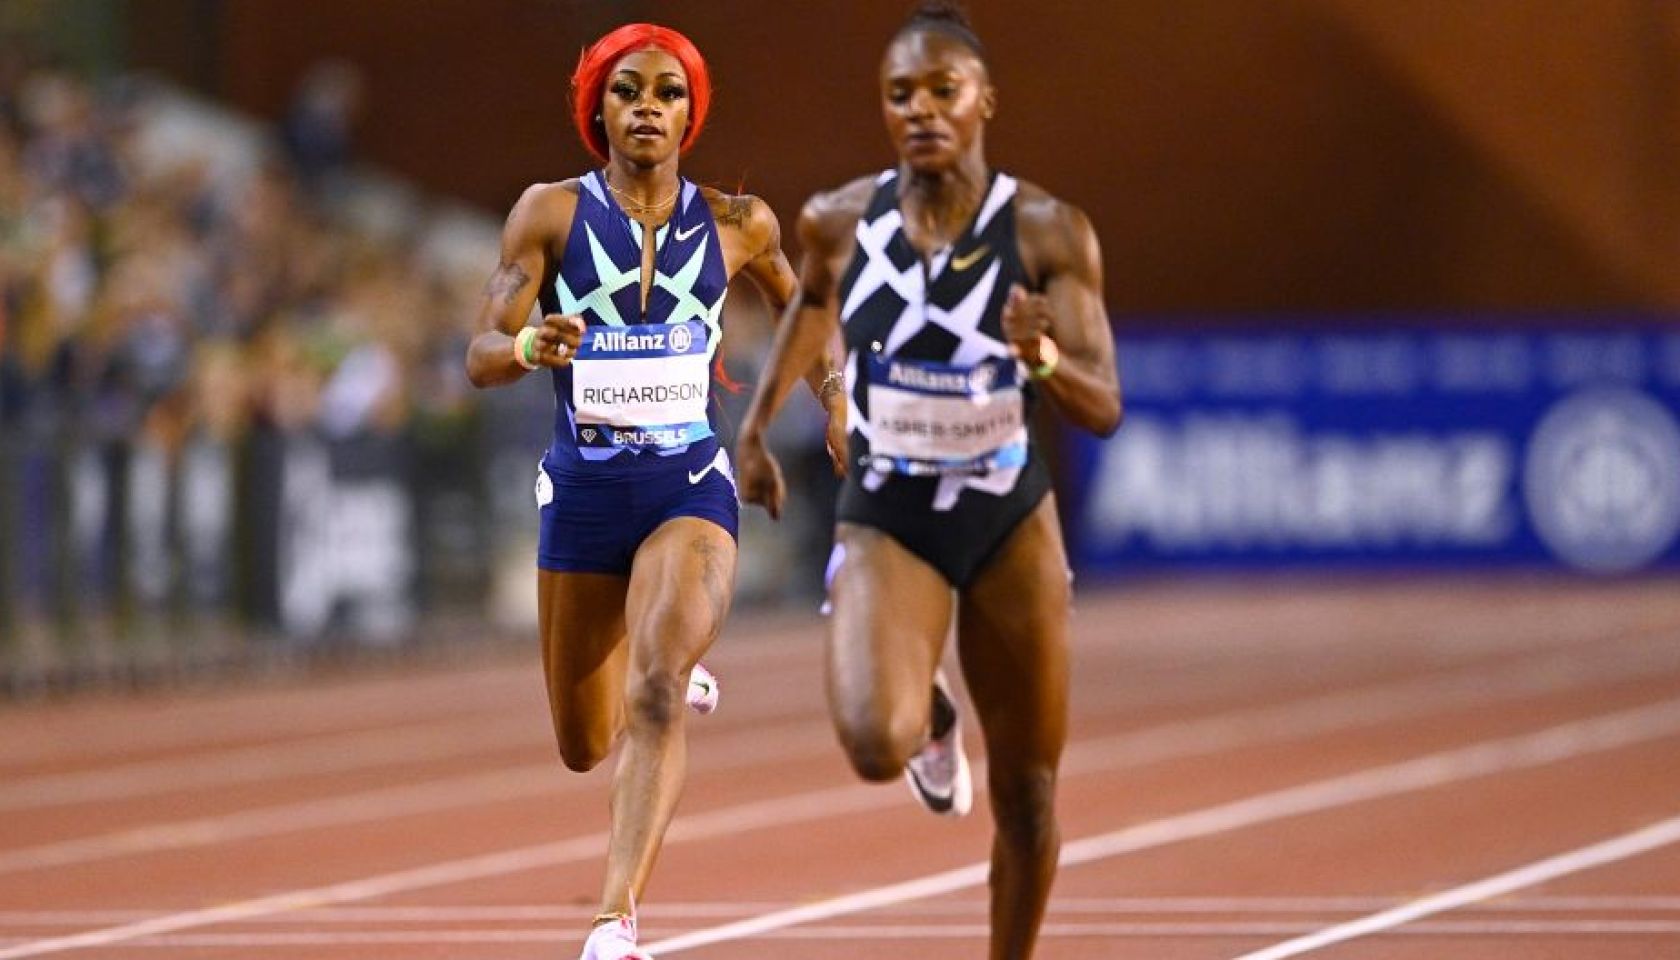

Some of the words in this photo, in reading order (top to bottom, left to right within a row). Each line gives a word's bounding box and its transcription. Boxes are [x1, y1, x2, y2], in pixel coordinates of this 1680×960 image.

[592, 332, 666, 352] Allianz
[583, 383, 703, 405] RICHARDSON
[613, 429, 688, 445] BRUSSELS
